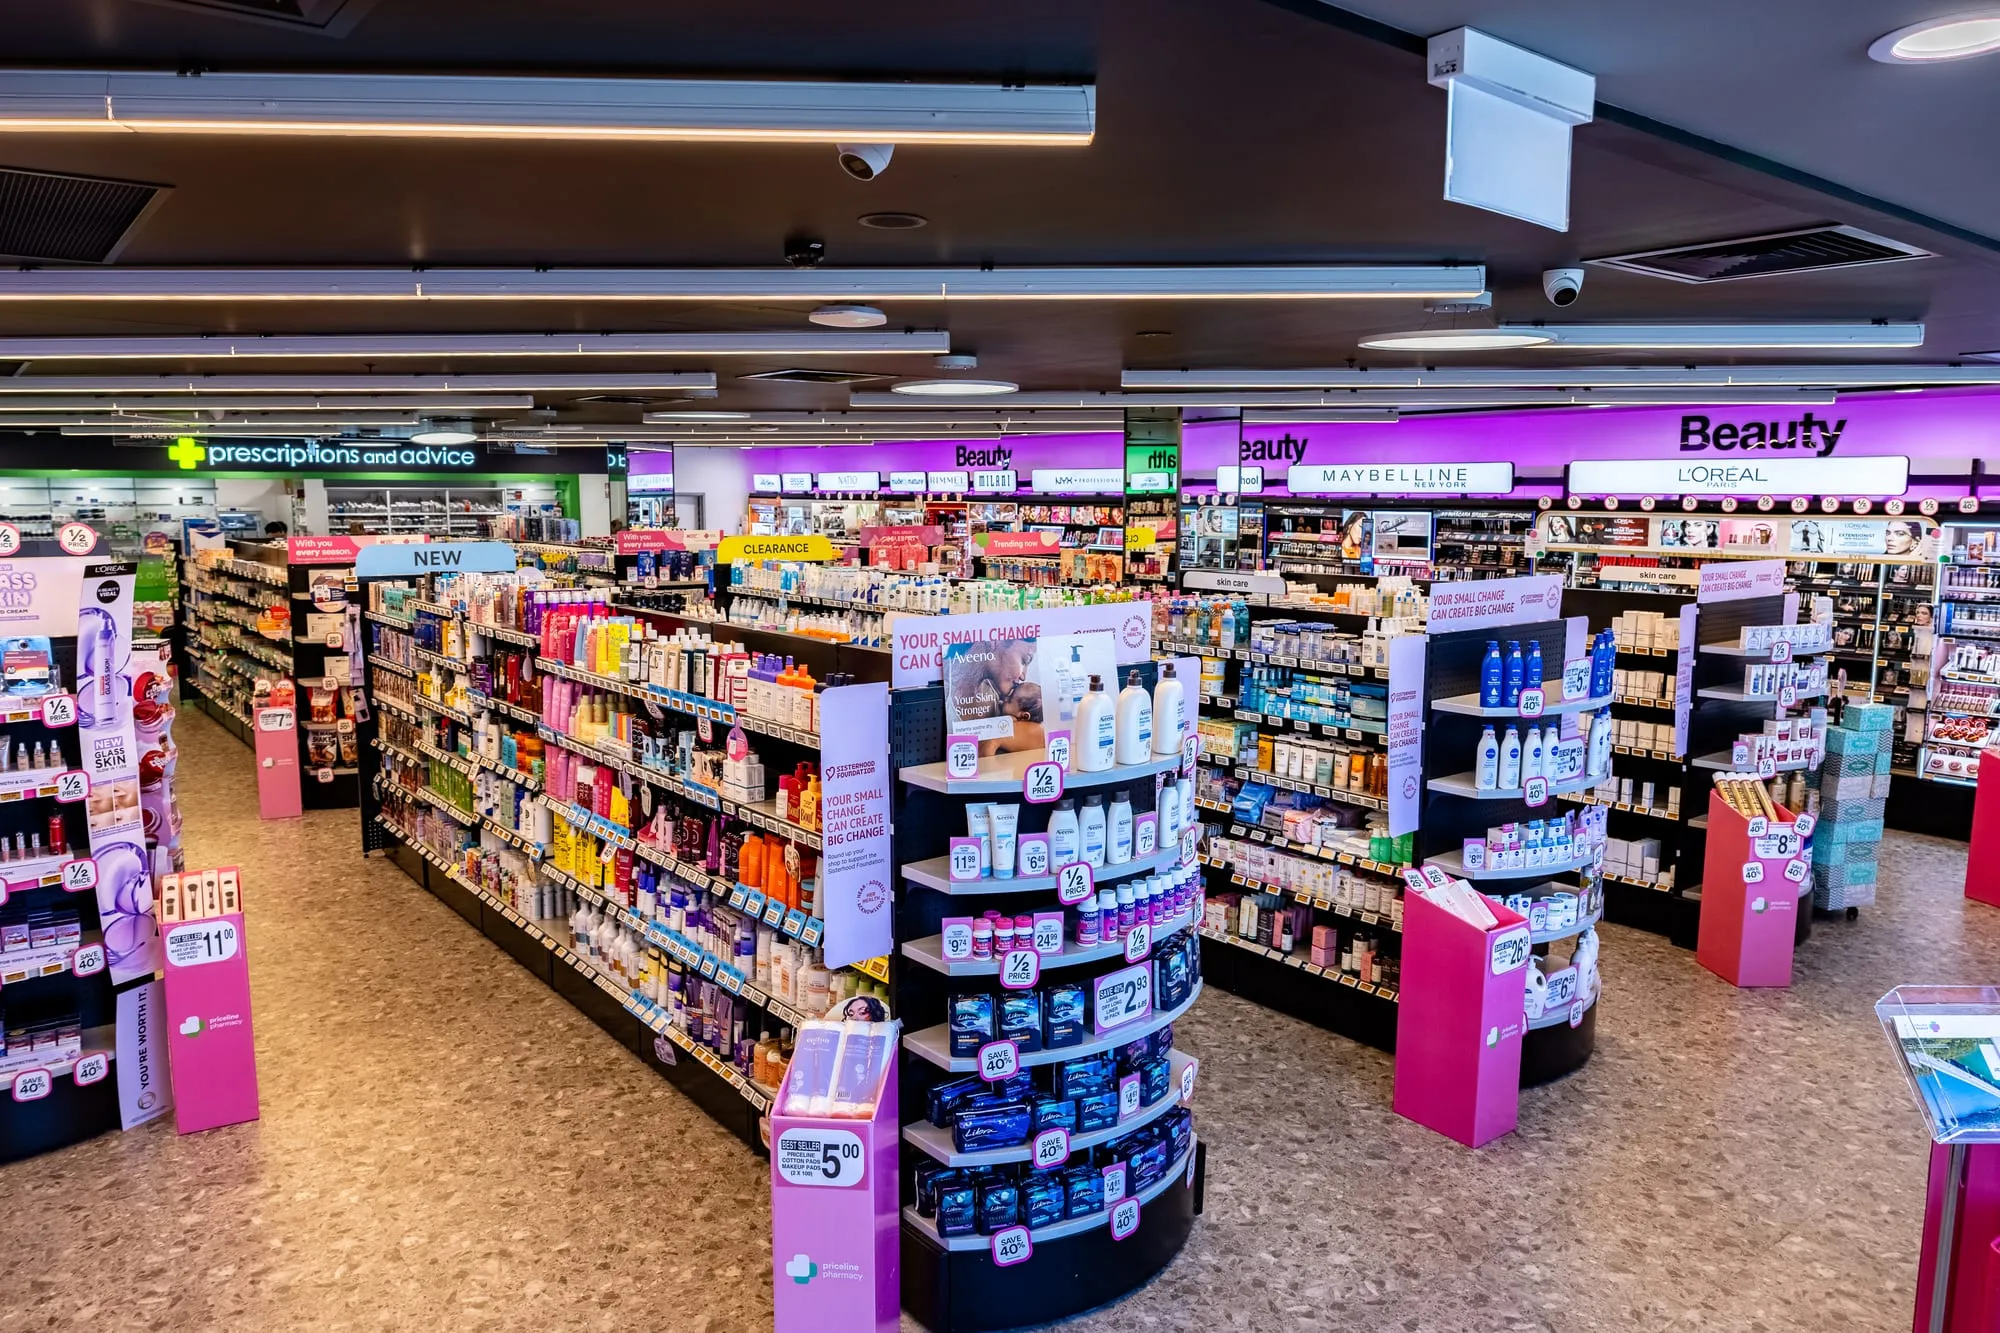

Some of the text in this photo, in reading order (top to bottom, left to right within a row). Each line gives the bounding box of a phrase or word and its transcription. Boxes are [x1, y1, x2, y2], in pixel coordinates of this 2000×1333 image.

[1680, 412, 1848, 456] Beauty
[208, 442, 476, 466] prescriptions and advice
[1241, 432, 1308, 465] eauty
[956, 446, 1012, 470] Beauty
[930, 476, 963, 484] RIMMEL
[978, 475, 1011, 487] MILANI
[1322, 468, 1468, 482] MAYBELLINE
[295, 539, 332, 549] With you
[639, 534, 652, 542] you
[624, 541, 640, 549] every
[744, 544, 808, 556] CLEARANCE
[994, 540, 1024, 549] Trending
[296, 549, 320, 557] every
[414, 550, 462, 567] NEW
[1640, 570, 1656, 578] skin
[1702, 573, 1714, 582] YOUR
[1715, 572, 1728, 580] SMALL
[1728, 570, 1747, 580] CHANGE
[1216, 578, 1232, 586] skin
[1700, 580, 1752, 593] CAN CREATE BIG CHANGE
[1433, 590, 1505, 606] YOUR SMALL CHANGE
[1432, 602, 1515, 620] CAN CREATE BIG CHANGE
[900, 624, 1040, 650] YOUR SMALL CHANGE
[900, 654, 931, 670] CAN
[954, 694, 974, 706] Your
[1523, 700, 1541, 710] 40%
[955, 704, 991, 716] Stronger
[1390, 710, 1419, 722] YOUR SMALL
[50, 714, 70, 722] PRICE
[1390, 720, 1410, 731] CHANGE
[1390, 728, 1418, 740] CAN CREATE
[95, 738, 122, 750] NEW
[1390, 736, 1418, 750] BIG CHANGE
[94, 748, 125, 760] GLASS
[95, 756, 126, 769] SKIN
[836, 760, 876, 772] SISTERHOOD
[836, 768, 876, 779] FOUNDATION
[62, 788, 84, 797] PRICE
[1032, 786, 1055, 794] PRICE
[1528, 788, 1544, 800] 40%
[1530, 784, 1542, 792] SAVE
[827, 788, 884, 808] YOUR SMALL
[826, 804, 866, 820] CHANGE
[827, 813, 884, 833] CAN CREATE
[828, 826, 884, 846] BIG CHANGE
[848, 854, 868, 864] support
[1427, 868, 1439, 876] SAVE
[70, 876, 92, 886] PRICE
[1066, 884, 1086, 896] PRICE
[1130, 943, 1146, 954] PRICE
[80, 950, 98, 960] SAVE
[79, 956, 102, 969] 40%
[1008, 972, 1031, 980] PRICE
[137, 1002, 148, 1046] WORTH
[210, 1014, 240, 1024] priceline
[210, 1019, 244, 1030] pharmacy
[987, 1050, 1009, 1060] SAVE
[82, 1060, 100, 1070] SAVE
[139, 1046, 150, 1090] YOU'RE
[986, 1056, 1012, 1072] 40%
[80, 1064, 104, 1078] 40%
[22, 1075, 43, 1086] SAVE
[19, 1082, 46, 1095] 40%
[782, 1140, 820, 1152] BEST SELLER
[1041, 1136, 1061, 1147] SAVE
[1040, 1142, 1064, 1158] 40%
[1118, 1206, 1133, 1220] SAVE
[1116, 1214, 1136, 1231] 40%
[1000, 1235, 1022, 1246] SAVE
[1000, 1242, 1026, 1258] 40%
[822, 1262, 860, 1271] priceline
[822, 1270, 864, 1282] pharmacy
